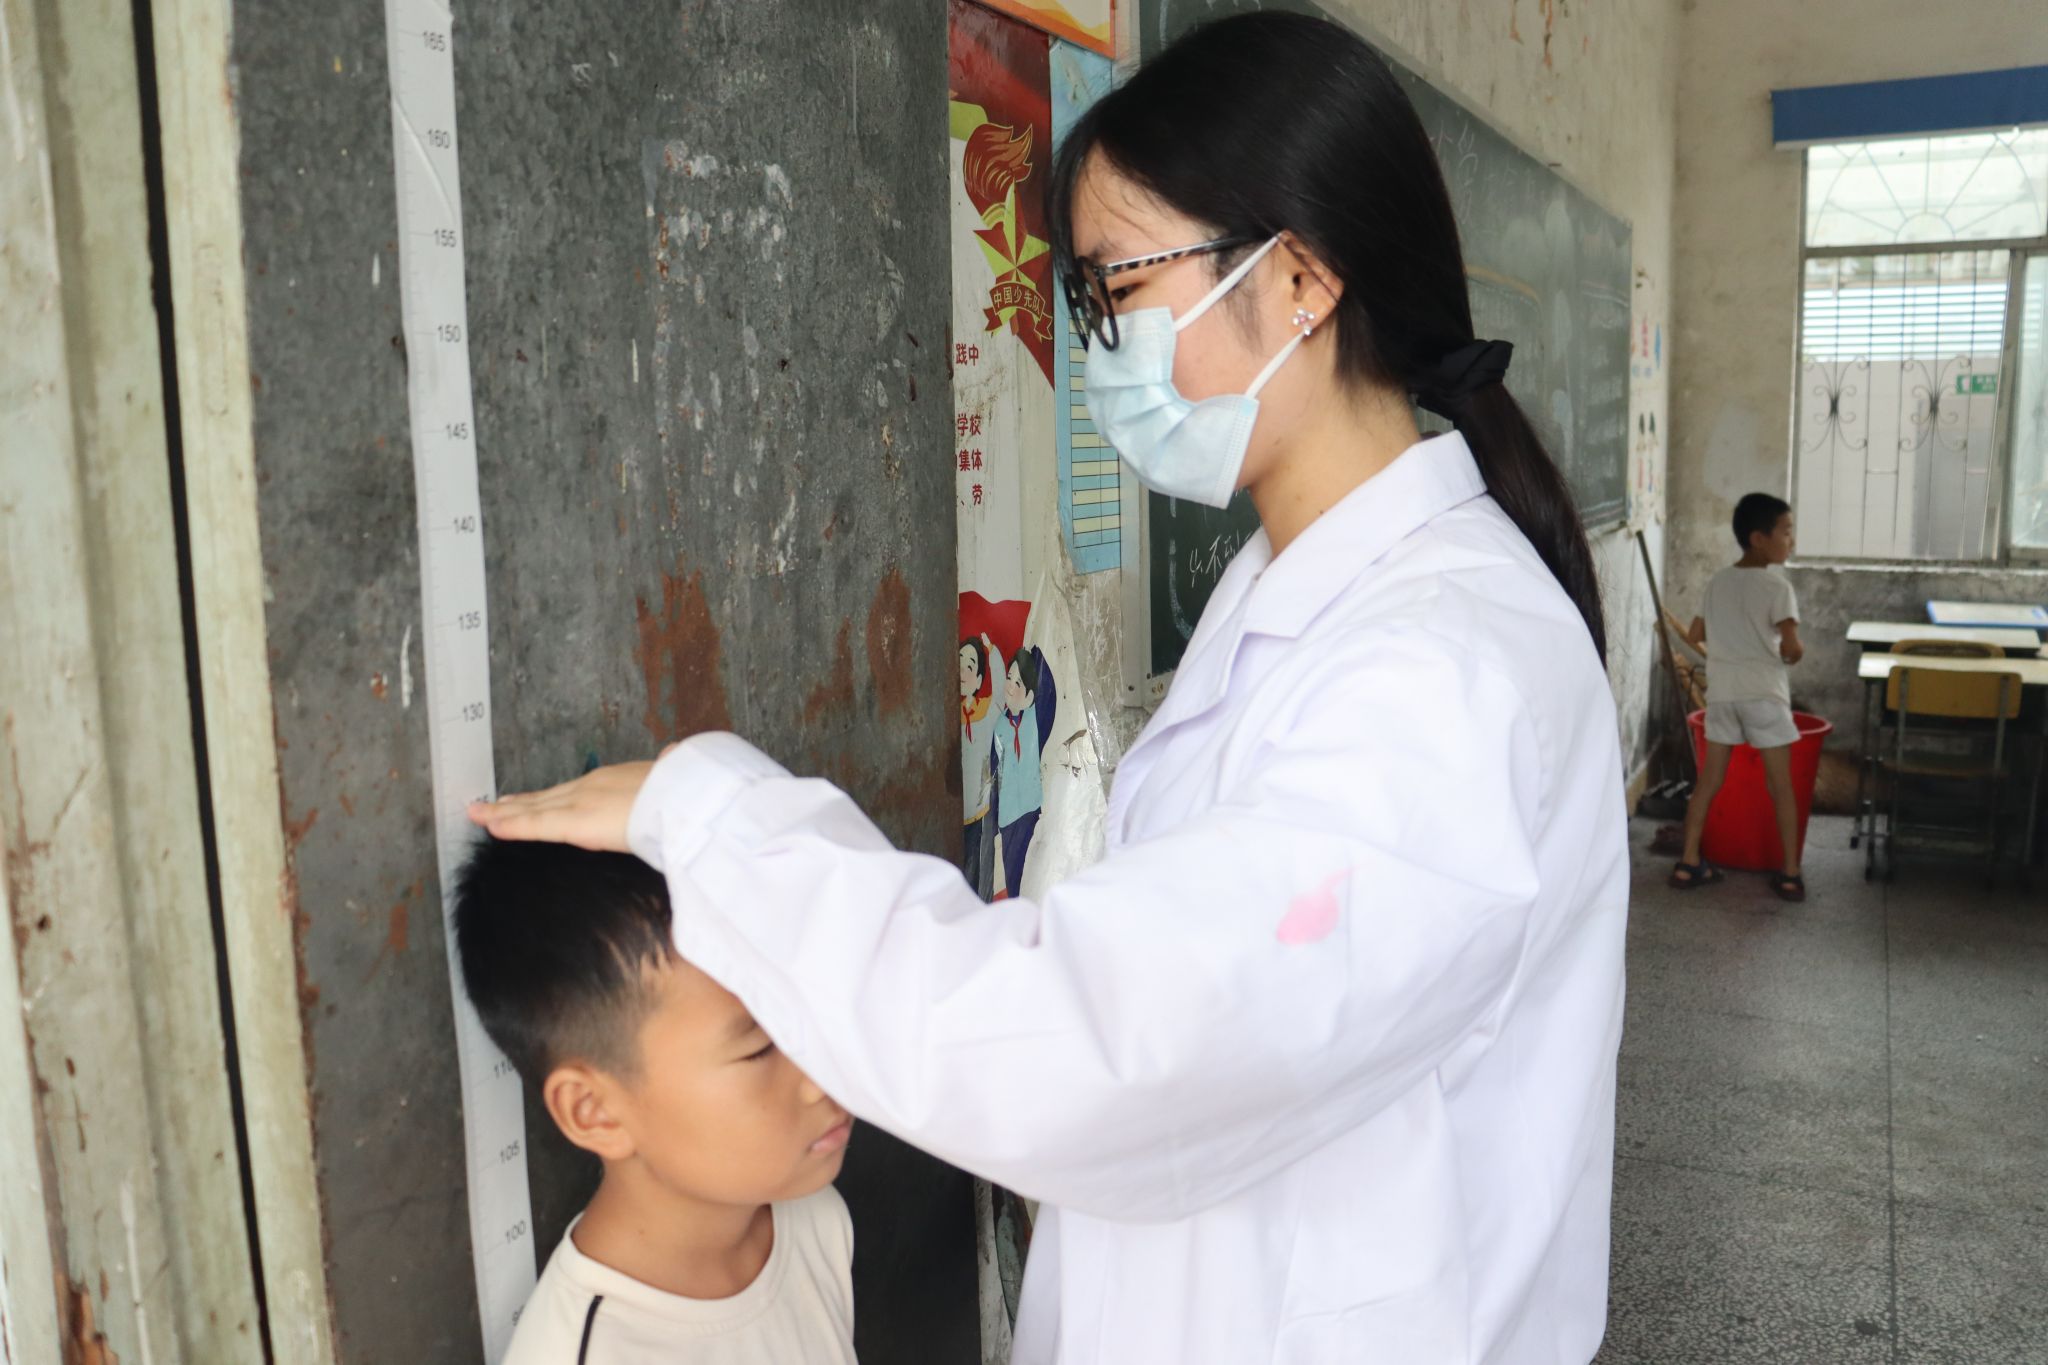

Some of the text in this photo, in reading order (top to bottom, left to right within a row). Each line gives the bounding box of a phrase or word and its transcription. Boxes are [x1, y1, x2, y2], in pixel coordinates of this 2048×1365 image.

[422, 30, 446, 52] 165
[427, 129, 451, 149] 160
[434, 229, 457, 248] 155
[993, 286, 1041, 316] 中国少先队
[437, 324, 462, 343] 150
[956, 343, 979, 366] 践中
[445, 423, 469, 440] 145
[957, 413, 982, 437] 学校
[955, 448, 983, 471] 集体
[453, 516, 476, 533] 140
[458, 611, 482, 631] 135
[462, 702, 485, 723] 130
[500, 1140, 521, 1164] 105
[504, 1220, 527, 1244] 100
